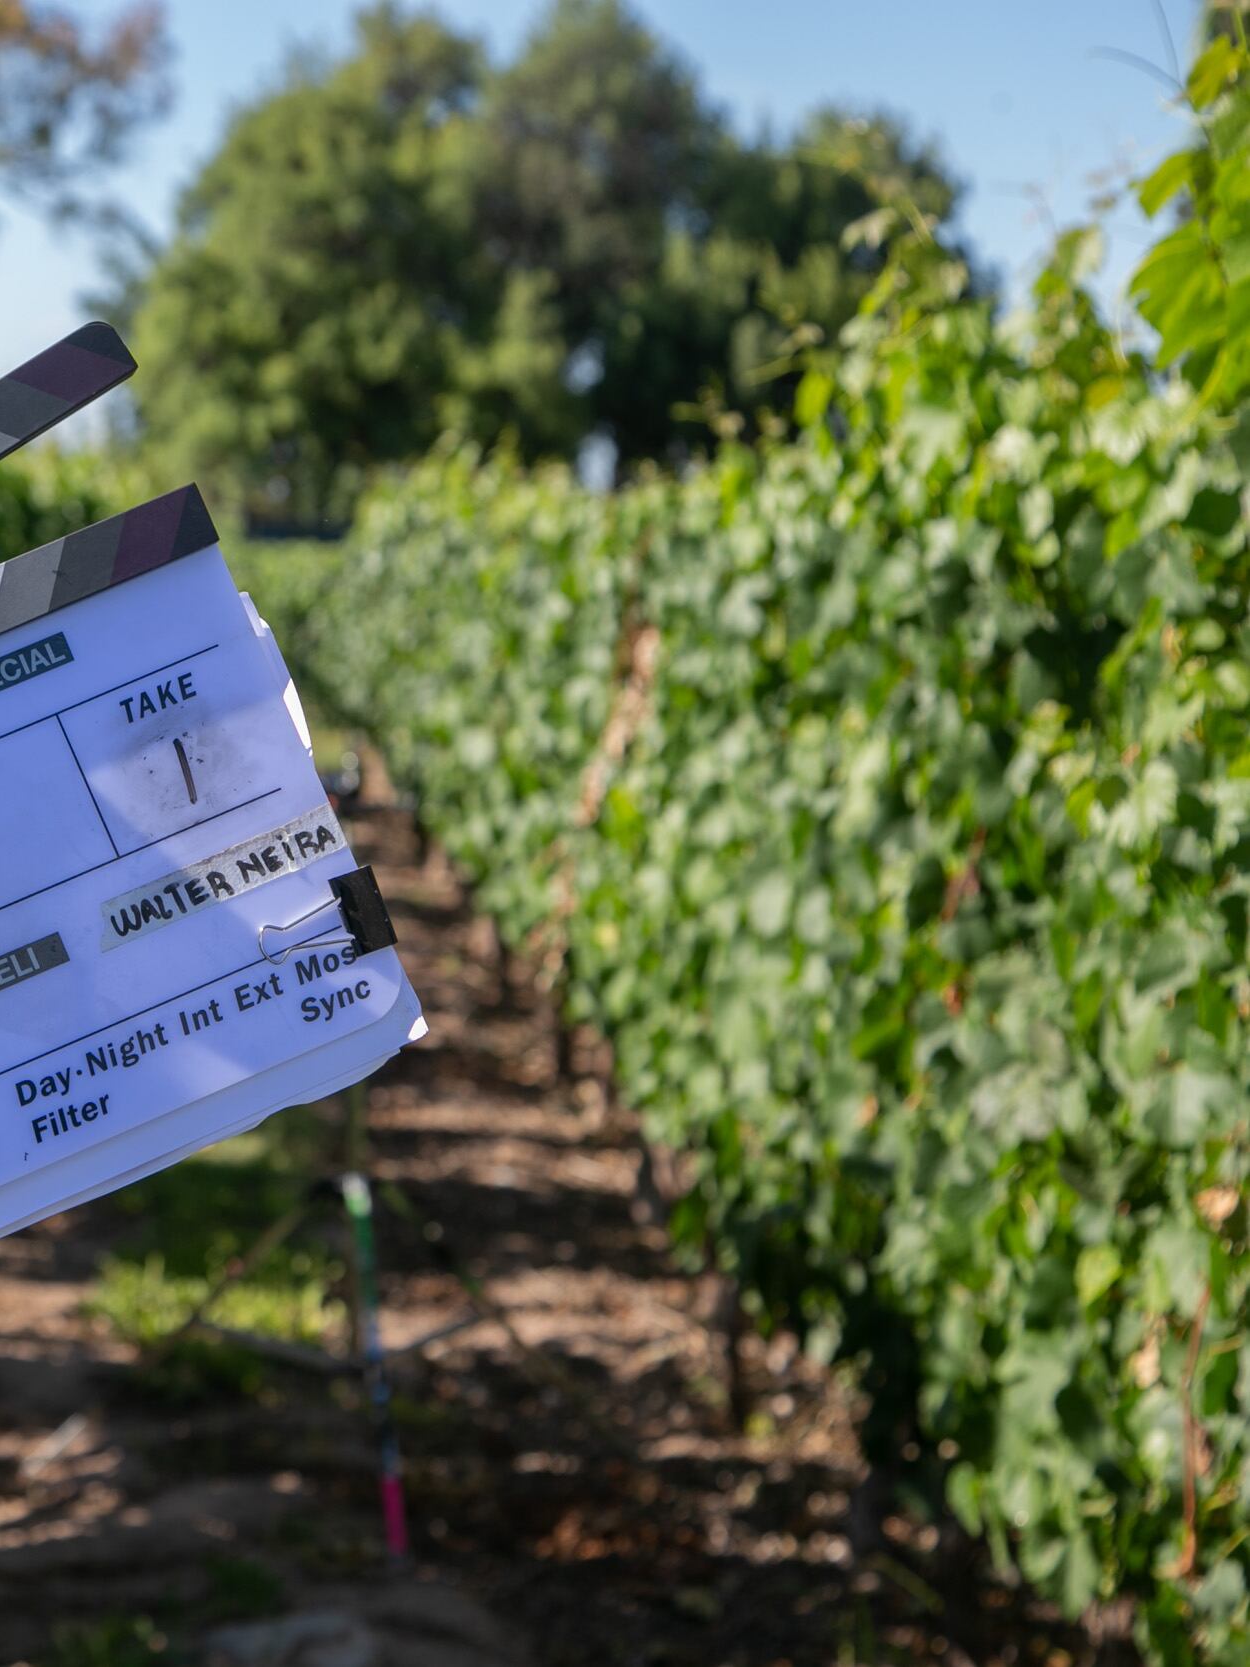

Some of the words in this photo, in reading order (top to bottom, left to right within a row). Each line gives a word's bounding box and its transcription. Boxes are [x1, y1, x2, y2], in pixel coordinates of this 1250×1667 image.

[119, 672, 198, 724] TAKE
[110, 871, 235, 937] WALTER
[179, 999, 224, 1036] Int
[233, 973, 284, 1012] Ext
[294, 945, 357, 986] Mos
[300, 979, 371, 1023] Sync
[31, 1094, 110, 1144] Filter
